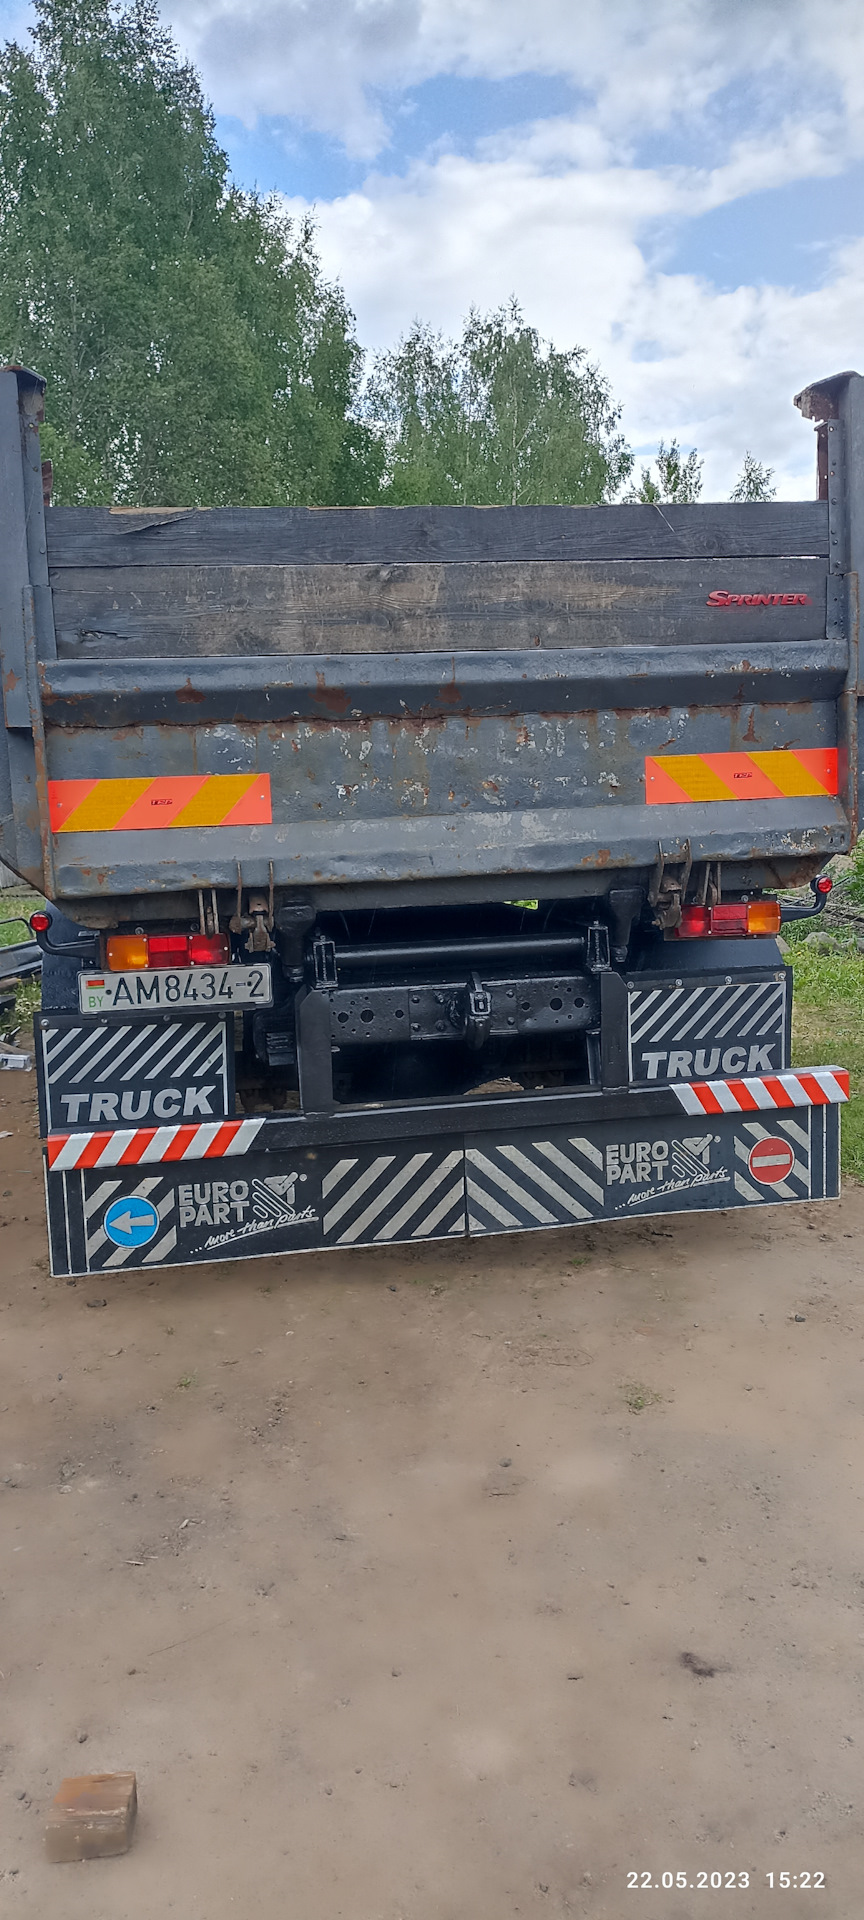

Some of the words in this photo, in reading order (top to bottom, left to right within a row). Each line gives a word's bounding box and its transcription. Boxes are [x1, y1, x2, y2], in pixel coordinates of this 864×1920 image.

[89, 996, 104, 1008] BY
[641, 1043, 776, 1079] TRUCK
[60, 1085, 216, 1122] TRUCK
[606, 1140, 669, 1165] EURO
[606, 1160, 669, 1186] PART
[656, 1178, 691, 1192] than
[690, 1166, 728, 1188] parts
[178, 1180, 249, 1206] EURO
[179, 1200, 250, 1228] PART
[237, 1219, 275, 1235] than
[274, 1205, 316, 1229] parts
